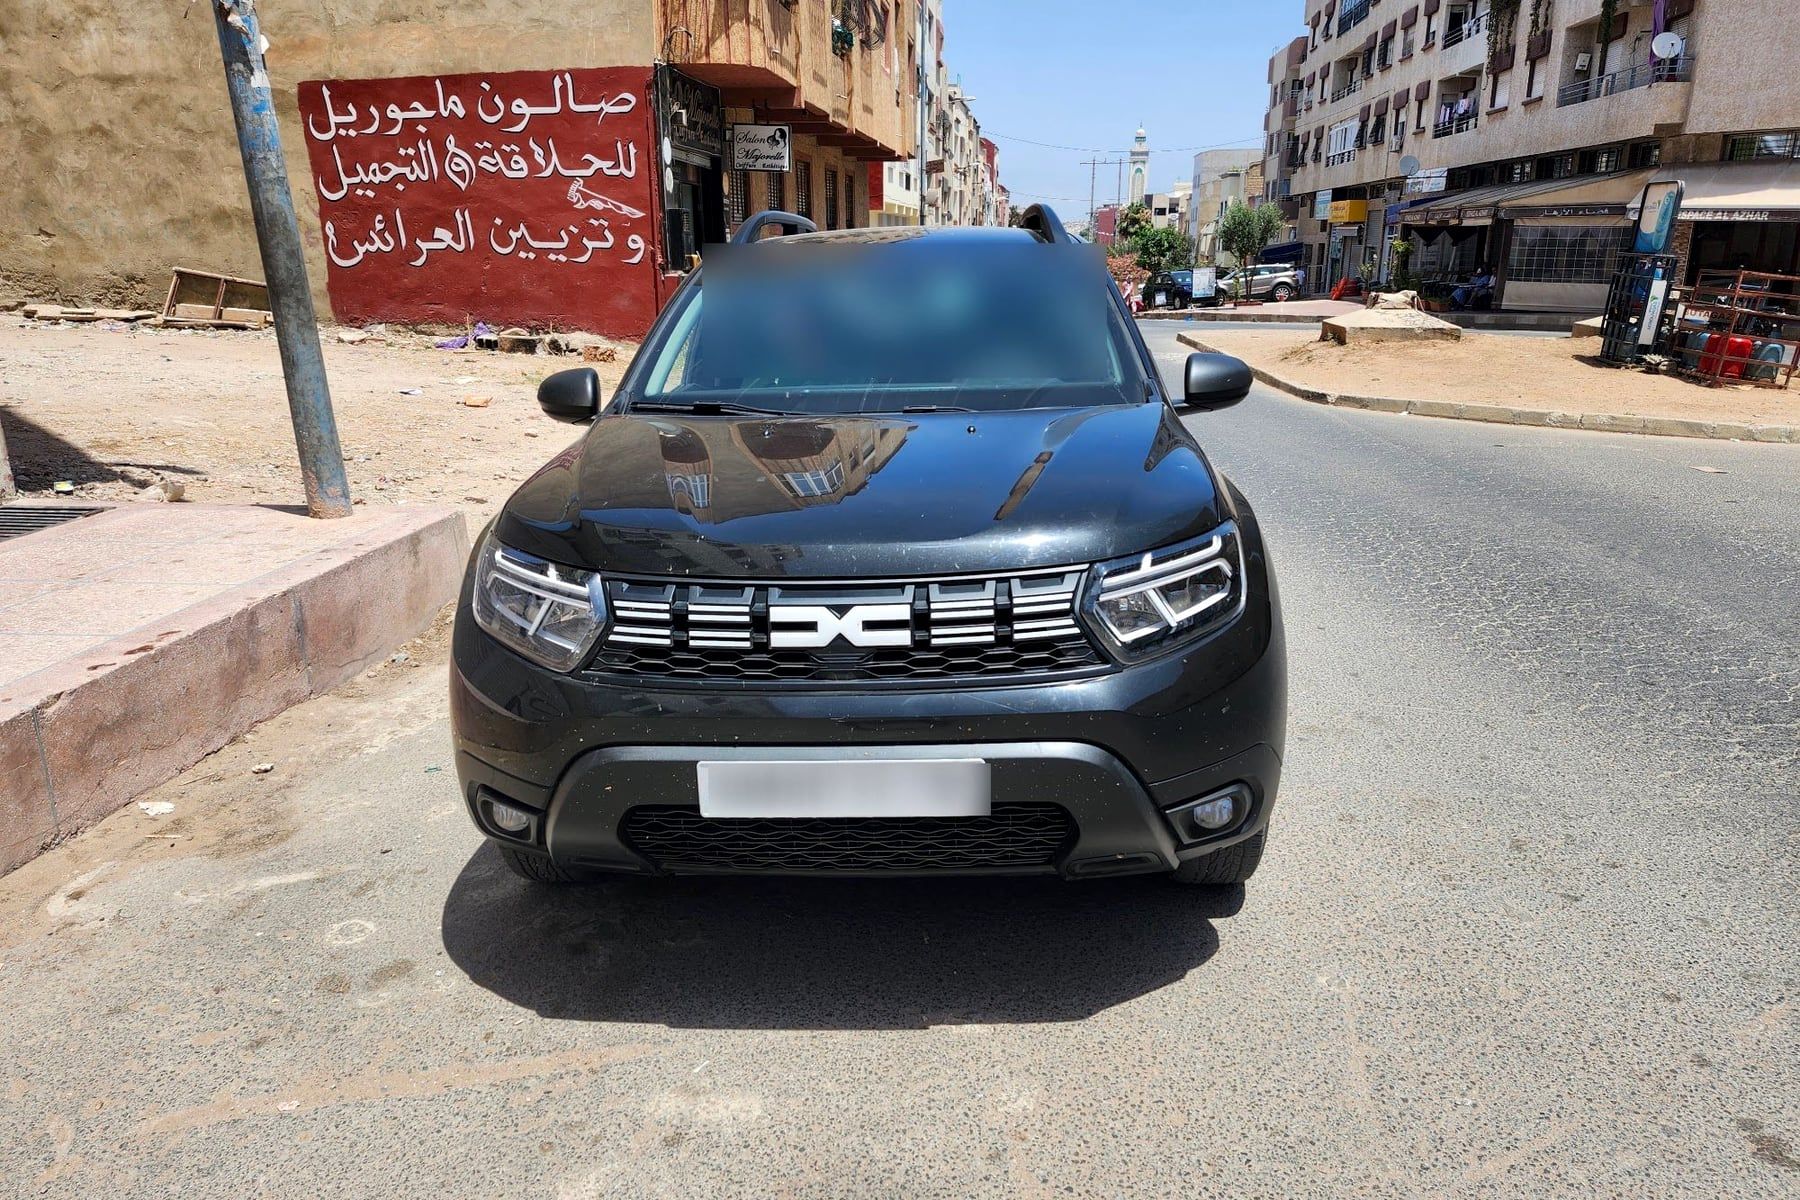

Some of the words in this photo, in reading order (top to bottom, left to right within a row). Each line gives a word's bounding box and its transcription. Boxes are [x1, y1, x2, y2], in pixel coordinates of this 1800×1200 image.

[308, 79, 466, 141] ماجوريل
[477, 72, 637, 133] صالون
[736, 130, 766, 144] Salon
[736, 148, 785, 163] Majorelle
[318, 138, 438, 201] التجميل
[324, 208, 475, 267] العرائس
[489, 216, 615, 263] تزيين
[1731, 211, 1769, 220] AZHAR
